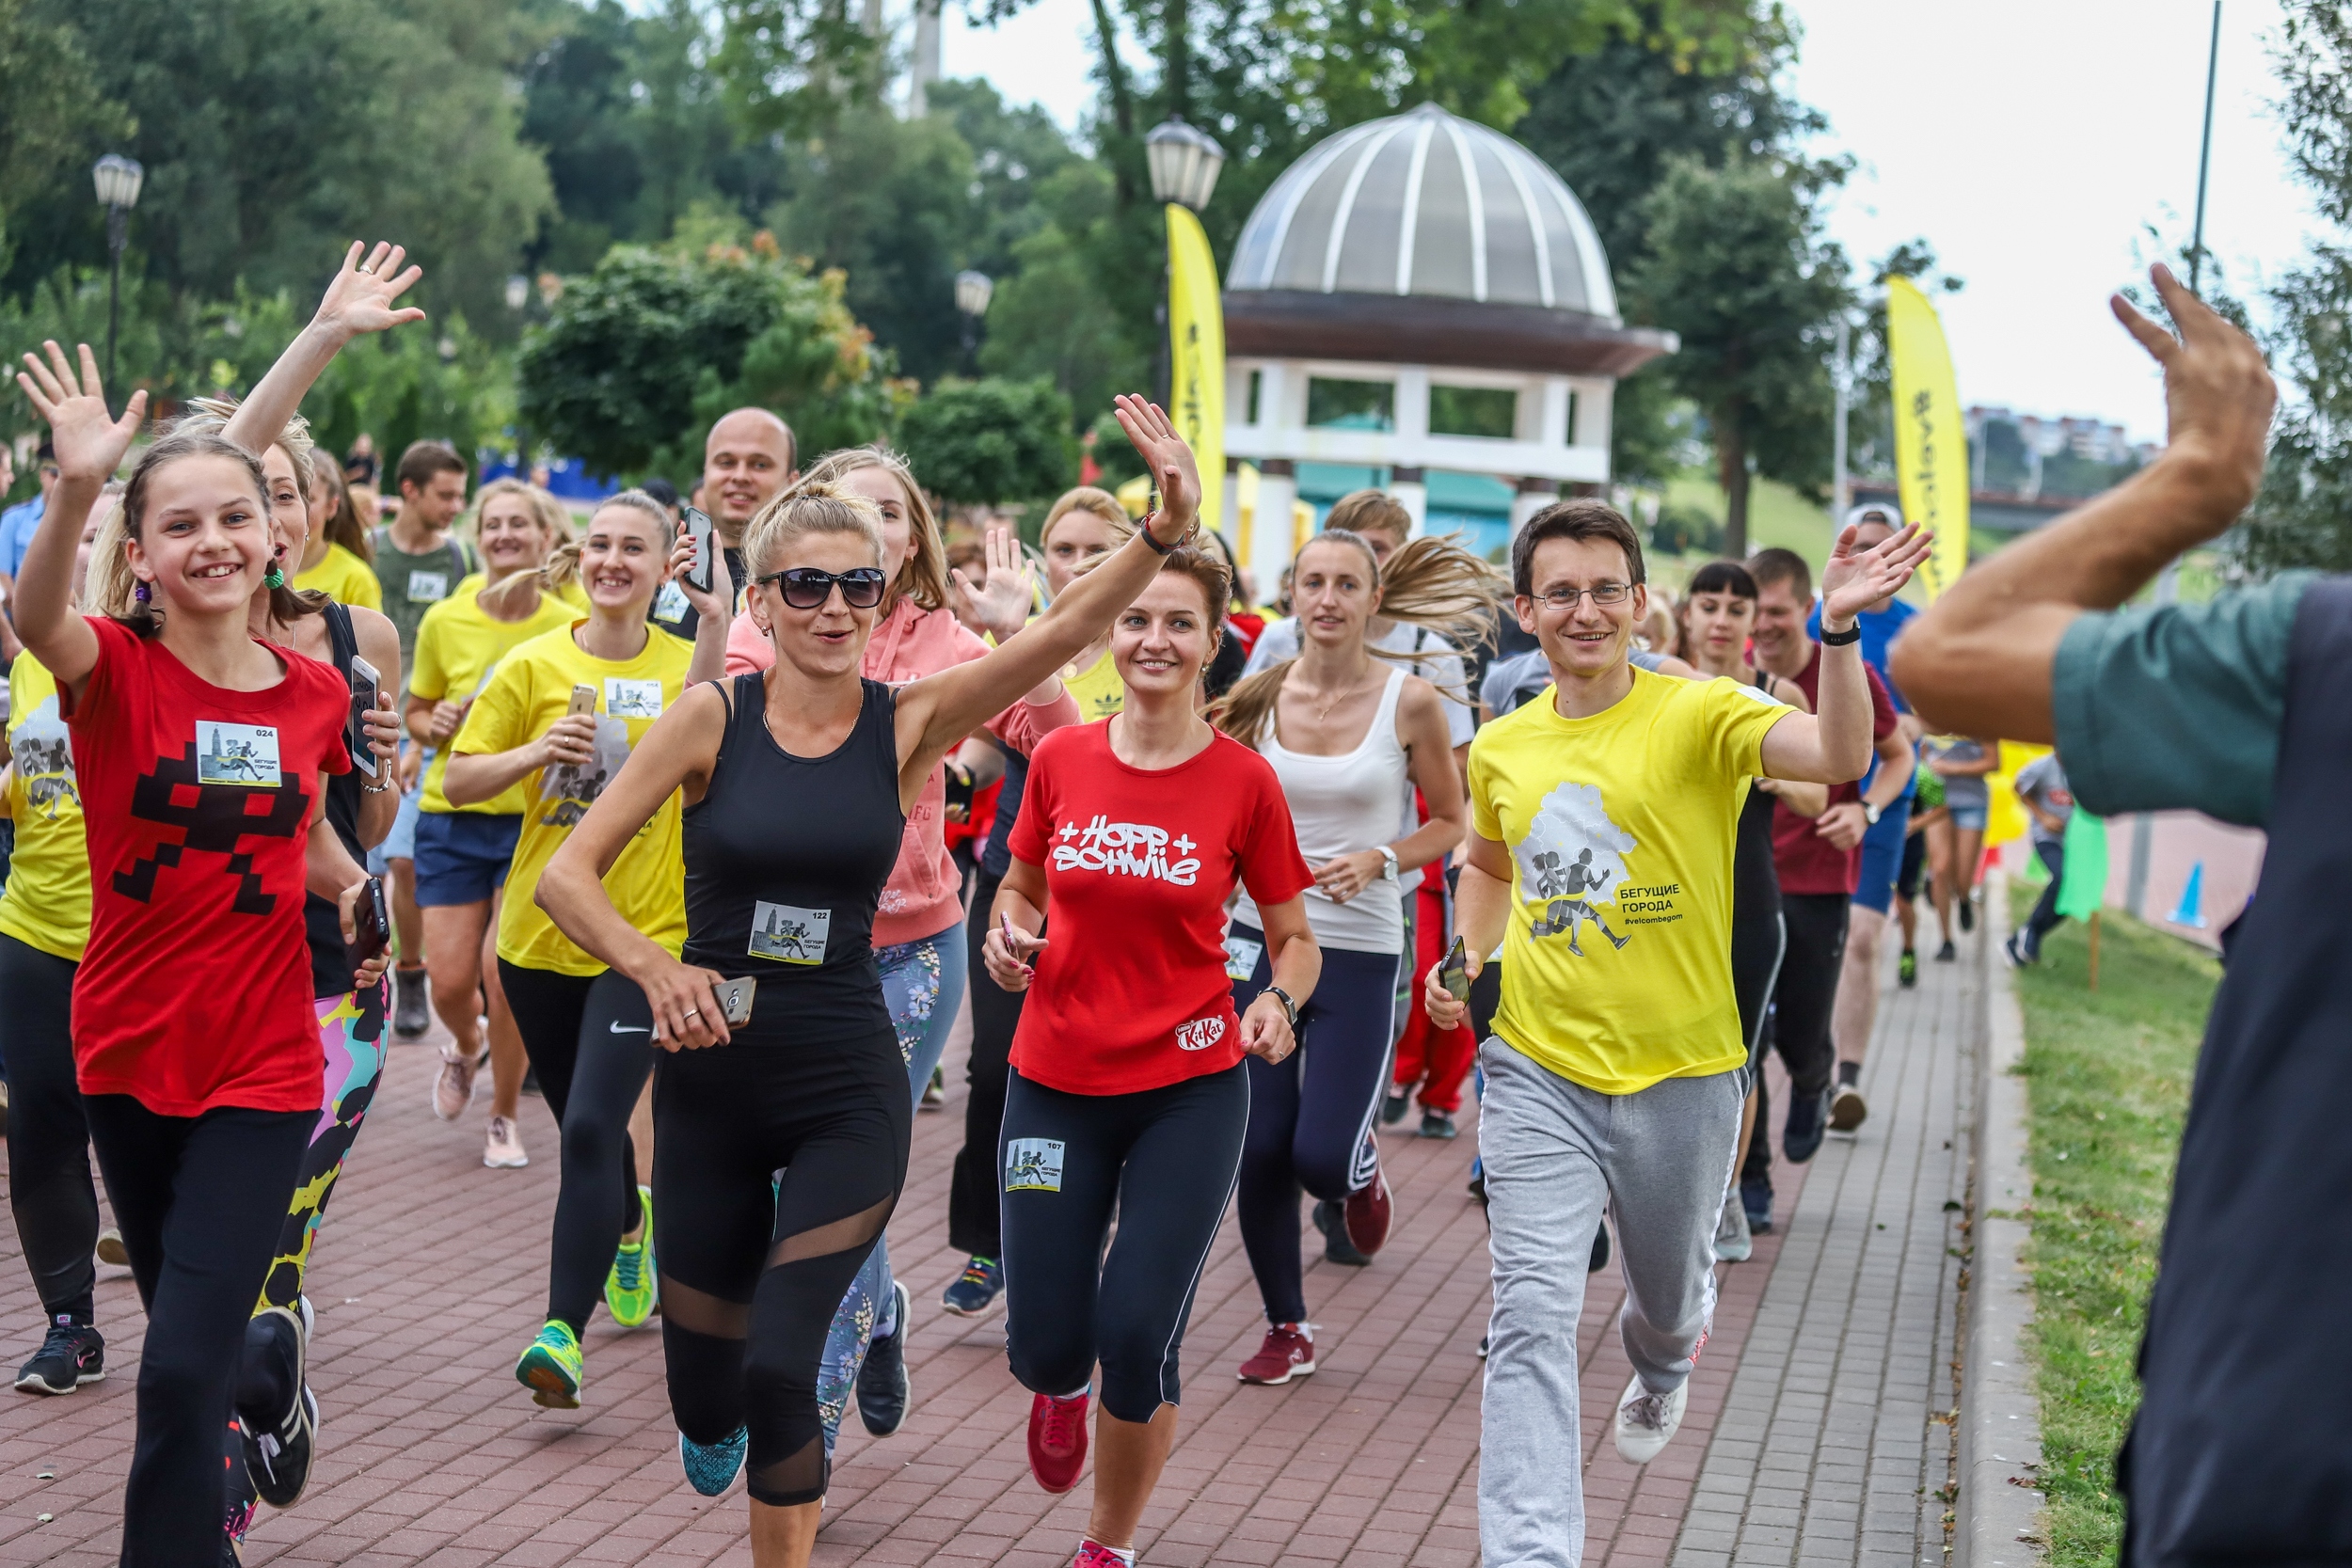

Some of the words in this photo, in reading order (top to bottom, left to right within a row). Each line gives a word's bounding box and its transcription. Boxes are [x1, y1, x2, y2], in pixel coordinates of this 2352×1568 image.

[256, 729, 274, 737] 024
[1620, 884, 1680, 899] БЕГУЩИЕ
[1622, 899, 1674, 913] ГОРОДА
[1625, 913, 1683, 926] #velcombegom
[1185, 1020, 1222, 1048] KitKat
[1047, 1142, 1061, 1150] 107
